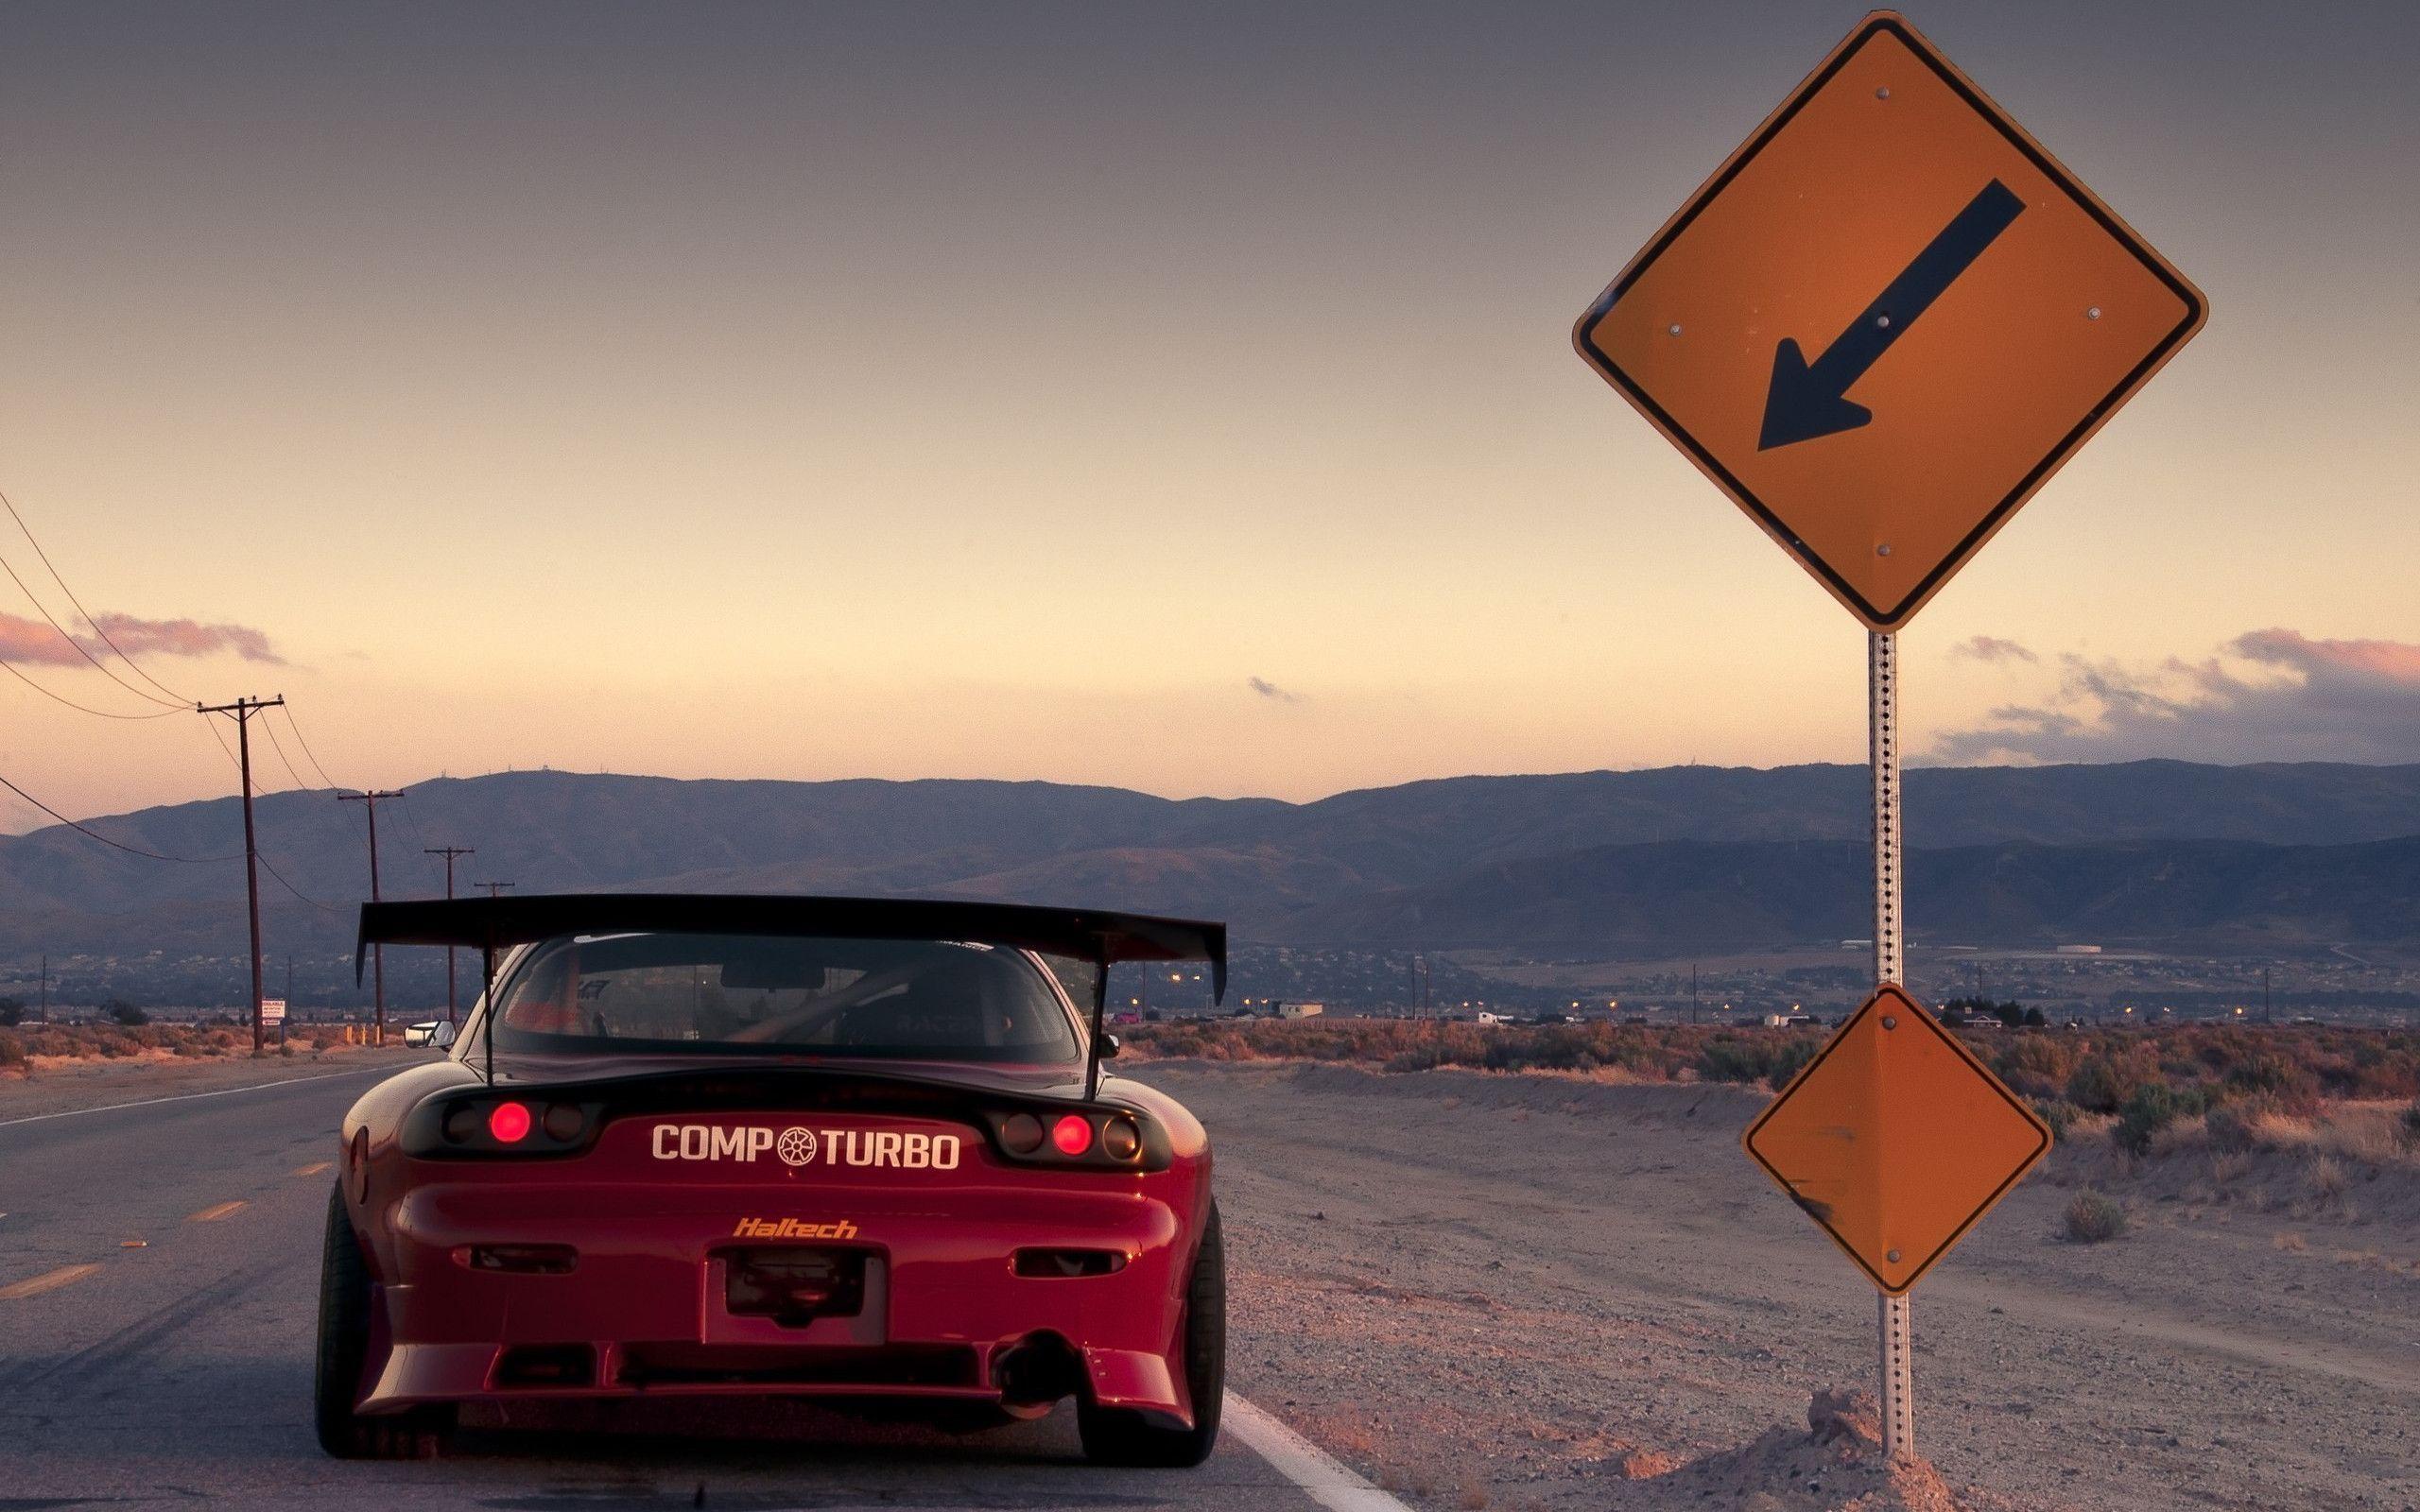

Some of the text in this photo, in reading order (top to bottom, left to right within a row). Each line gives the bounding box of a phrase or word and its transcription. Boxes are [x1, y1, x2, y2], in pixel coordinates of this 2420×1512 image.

[653, 1125, 959, 1169] COMP TURBO
[734, 1218, 857, 1238] Haltech
